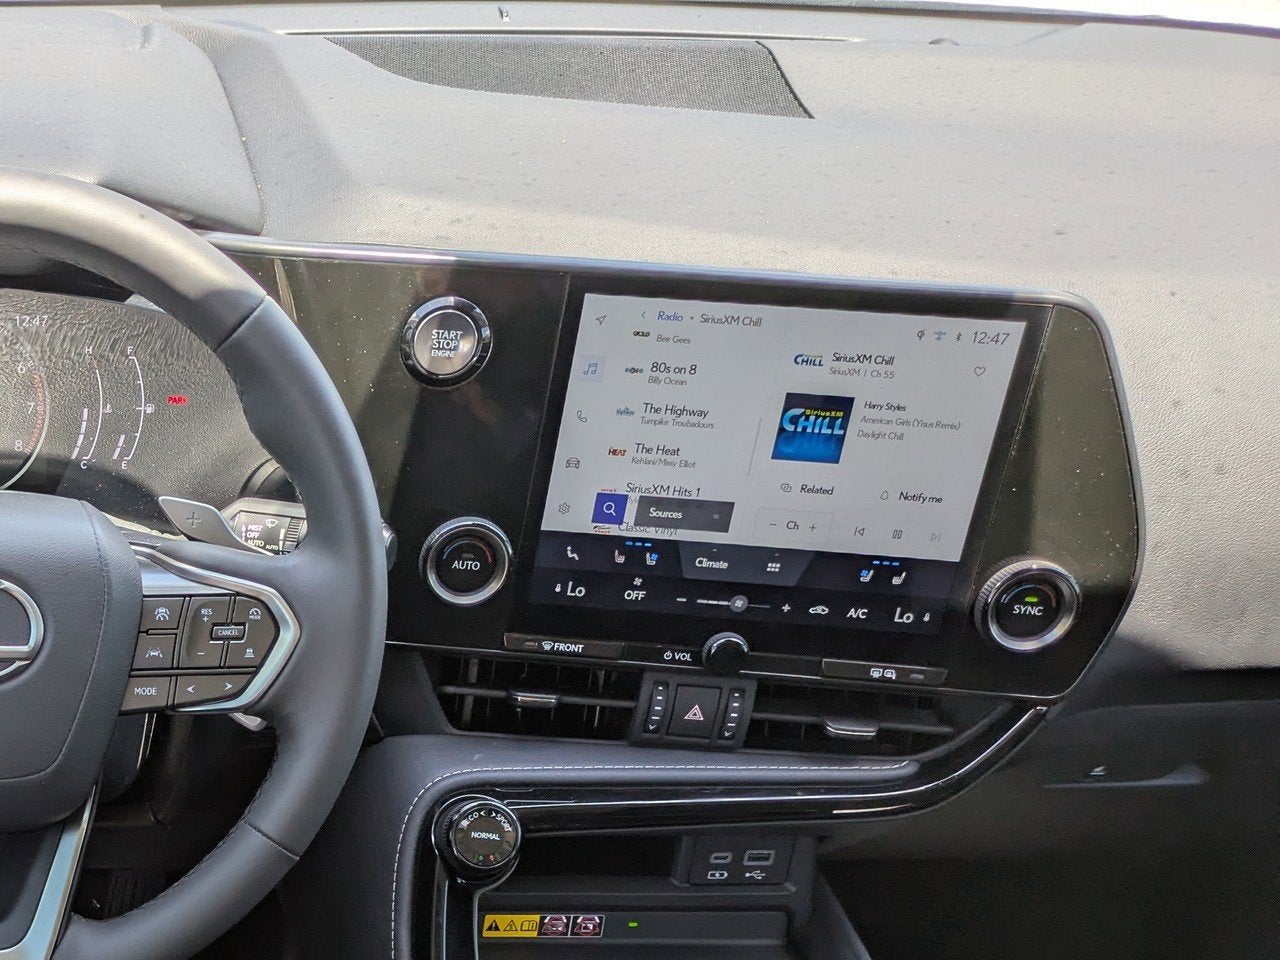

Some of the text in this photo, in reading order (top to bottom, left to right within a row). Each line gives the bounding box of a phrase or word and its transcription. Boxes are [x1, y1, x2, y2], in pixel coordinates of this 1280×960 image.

[15, 315, 48, 327] 12:47
[657, 310, 763, 327] Radio SiriusXM Chill
[431, 329, 463, 341] START
[656, 334, 691, 345] Bee Gees
[971, 330, 1011, 346] 12:47
[432, 340, 458, 349] STOP
[85, 346, 93, 355] H
[127, 346, 134, 355] F
[431, 350, 457, 358] ENGINE
[794, 354, 824, 367] CHILL
[831, 352, 872, 365] SiriusXM
[874, 354, 895, 366] Chill
[18, 363, 26, 374] 6
[650, 361, 671, 374] 80s
[673, 365, 686, 375] on
[689, 364, 698, 376] 8
[828, 366, 895, 379] SiriusXM Ch 55
[648, 376, 687, 386] Billy Ocean
[27, 403, 35, 414] 7
[643, 402, 709, 419] The Highway
[864, 401, 906, 412] Harry Styles
[671, 418, 714, 429] Troubadours
[782, 408, 845, 435] CHILL
[860, 416, 894, 426] American
[857, 430, 904, 441] Daylight Chill
[15, 440, 23, 451] 8
[635, 443, 680, 456] The Heat
[80, 460, 88, 469] C
[121, 460, 128, 470] E
[625, 482, 670, 495] SiriusXM
[672, 486, 692, 497] Hits
[696, 487, 701, 498] 1
[800, 484, 834, 495] Related
[899, 491, 943, 504] Notify me
[649, 507, 682, 519] Sources
[786, 520, 799, 530] Ch
[451, 560, 480, 570] AUTO
[695, 557, 729, 570] Climate
[566, 580, 586, 597] Lo
[624, 590, 646, 600] OFF
[847, 607, 868, 619] A/C
[894, 606, 914, 623] Lo
[1012, 604, 1043, 615] SYNC
[554, 643, 584, 653] FRONT
[674, 652, 692, 661] VOL
[134, 687, 158, 696] MODE
[495, 814, 512, 832] SPORT
[470, 831, 501, 840] NORMAL
